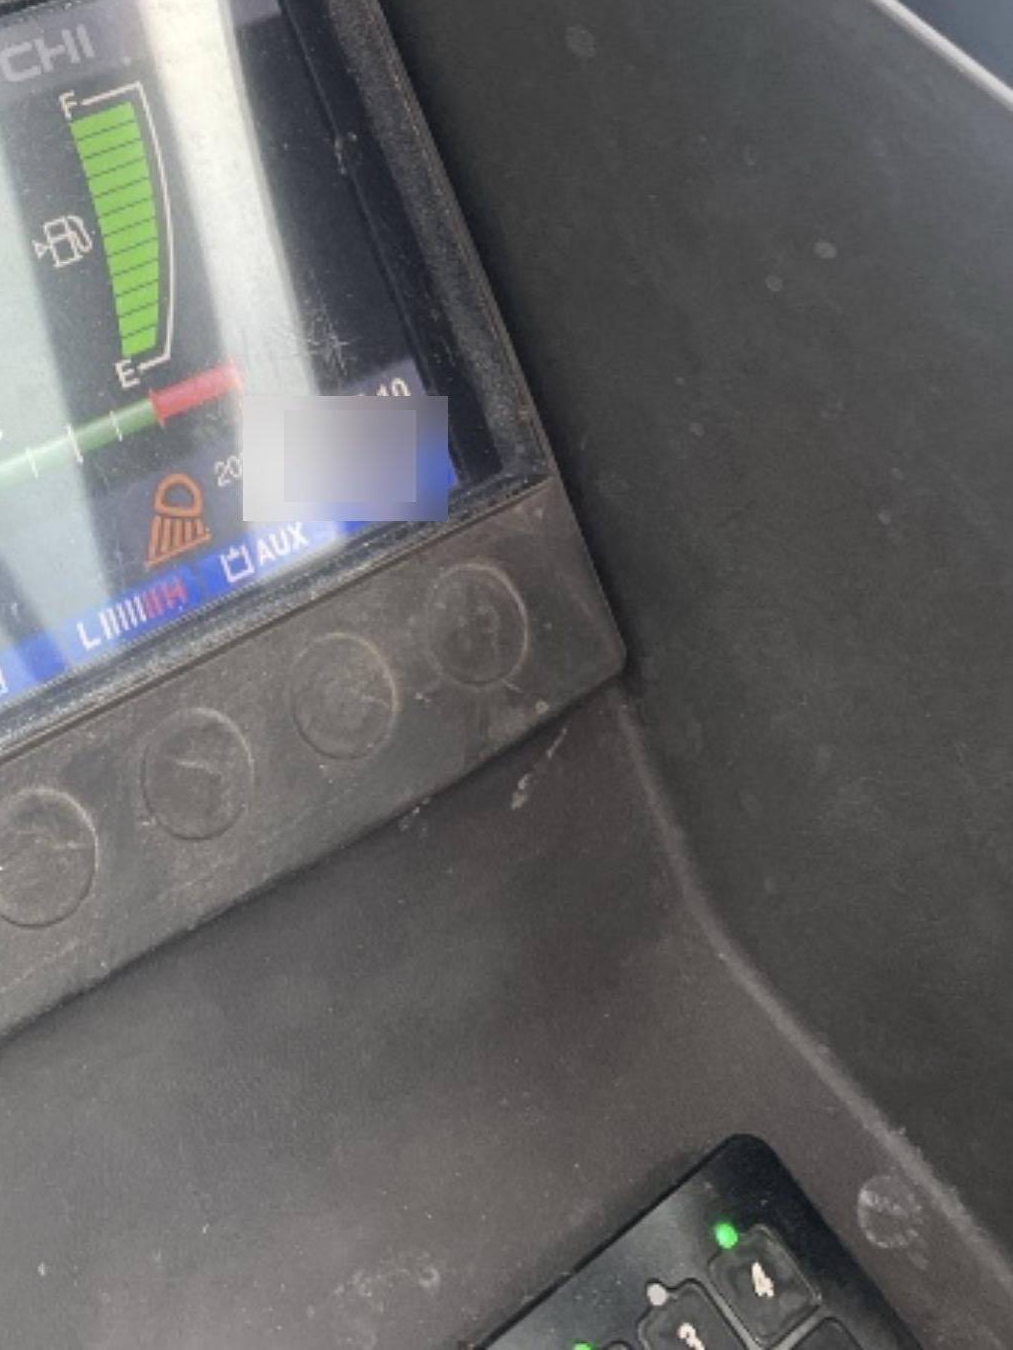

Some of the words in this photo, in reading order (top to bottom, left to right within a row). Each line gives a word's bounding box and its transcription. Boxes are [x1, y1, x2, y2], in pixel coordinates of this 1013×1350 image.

[58, 90, 78, 120] F
[114, 358, 139, 389] E
[256, 521, 309, 567] AUX
